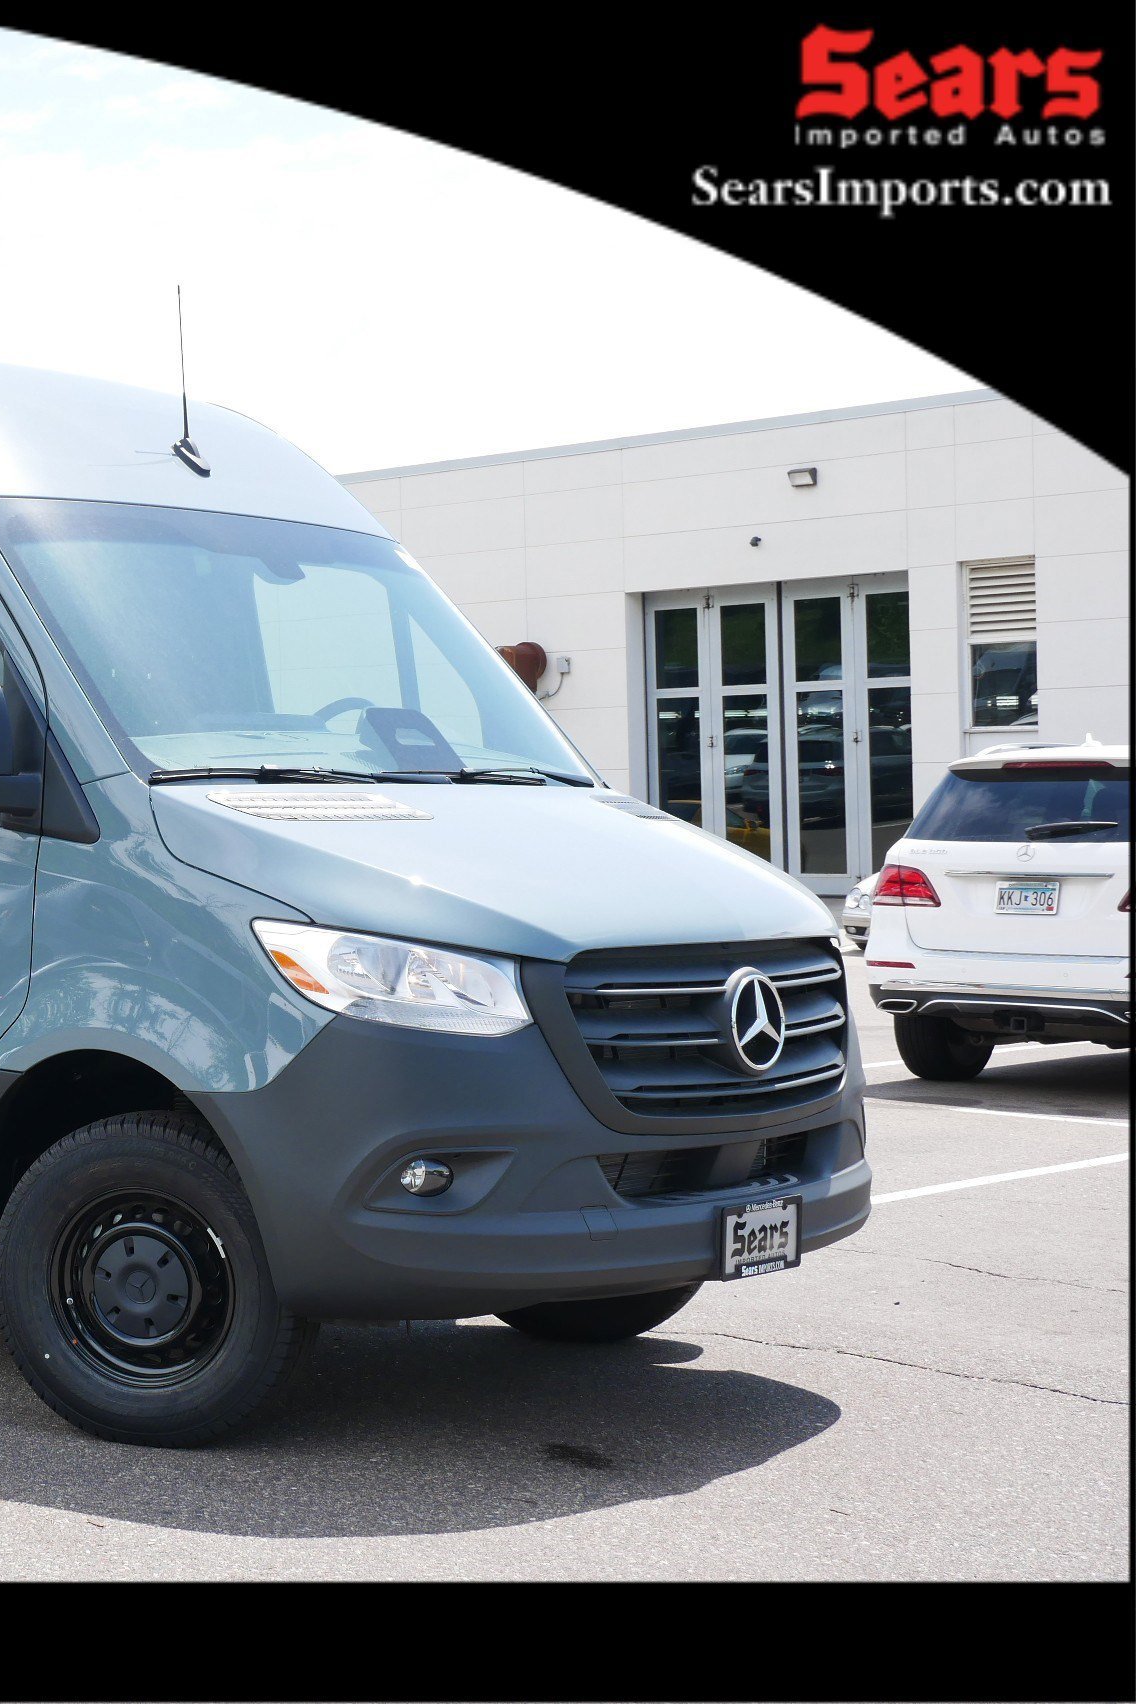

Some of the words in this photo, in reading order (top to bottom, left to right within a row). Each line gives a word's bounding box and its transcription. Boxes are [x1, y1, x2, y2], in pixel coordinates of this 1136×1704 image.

[998, 890, 1023, 906] KKJ
[1031, 891, 1054, 906] 306
[730, 1220, 790, 1259] Sears
[741, 1265, 758, 1277] Sears
